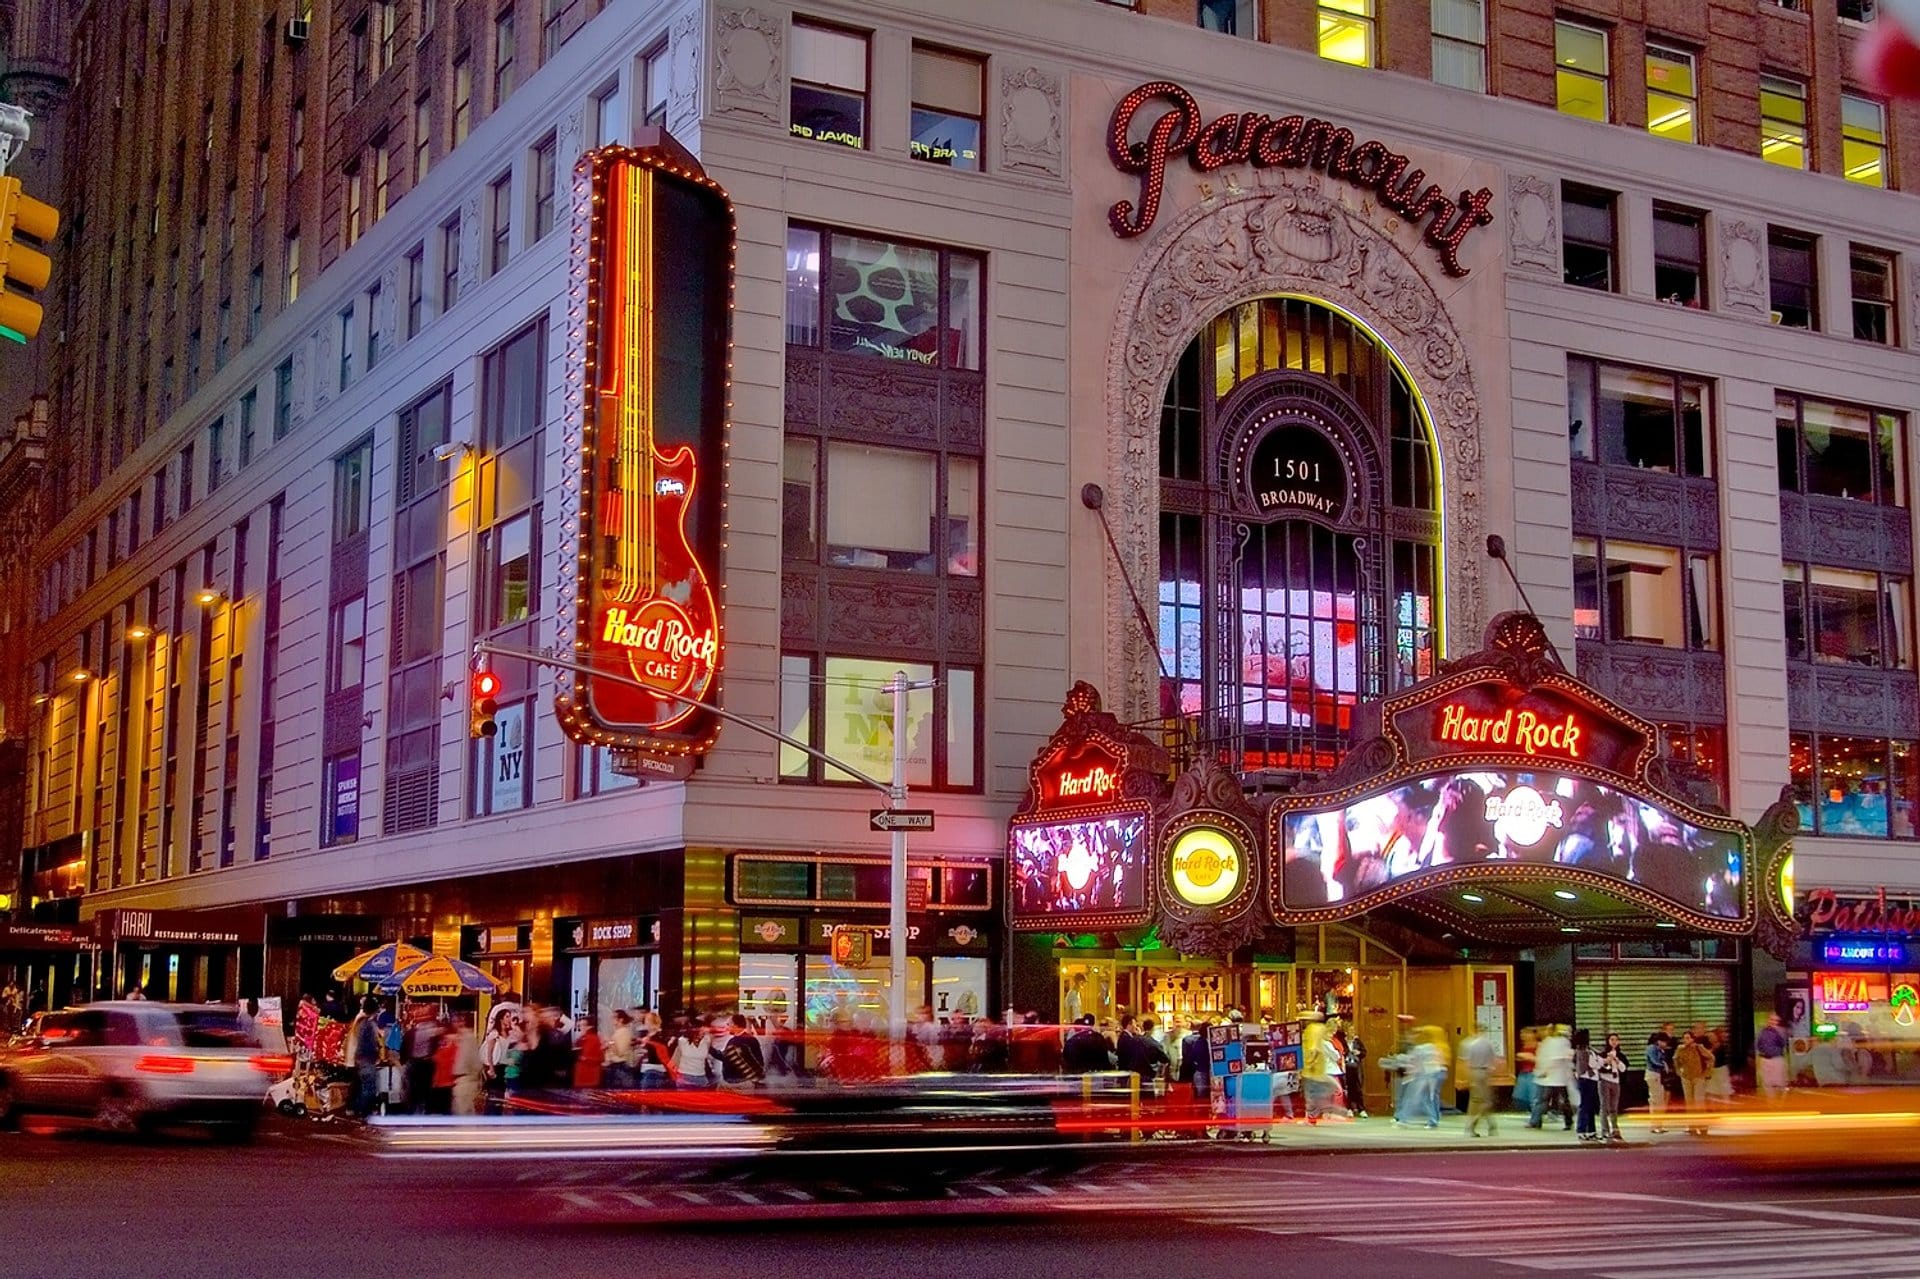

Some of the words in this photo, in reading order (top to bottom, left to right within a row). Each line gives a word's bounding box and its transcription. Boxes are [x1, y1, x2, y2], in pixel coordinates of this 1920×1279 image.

[1107, 81, 1494, 279] Paramount
[1274, 457, 1320, 482] 1501
[1260, 489, 1334, 514] BROADWAY
[602, 607, 664, 650] Hard
[663, 618, 716, 667] Rock
[645, 661, 678, 680] CAFE
[500, 720, 507, 748] I
[1441, 704, 1512, 744] Hard
[1515, 711, 1580, 757] Rock
[499, 750, 523, 782] NY
[1060, 769, 1094, 796] Hard
[1093, 767, 1117, 797] Roc
[878, 815, 896, 825] ONE
[908, 816, 927, 825] WAY
[1488, 799, 1523, 817] Hard
[1175, 857, 1203, 872] Hard
[1204, 855, 1235, 872] Rock
[9, 926, 61, 935] Delicatessen
[121, 911, 152, 937] HARU
[154, 930, 197, 940] RESTAURANT
[202, 932, 223, 941] SUSHI
[224, 933, 239, 941] BAR
[593, 926, 612, 940] ROCK
[612, 925, 632, 939] SHOP
[406, 984, 458, 993] SABRETT
[1823, 976, 1869, 1002] PIZZA
[938, 992, 950, 1011] I
